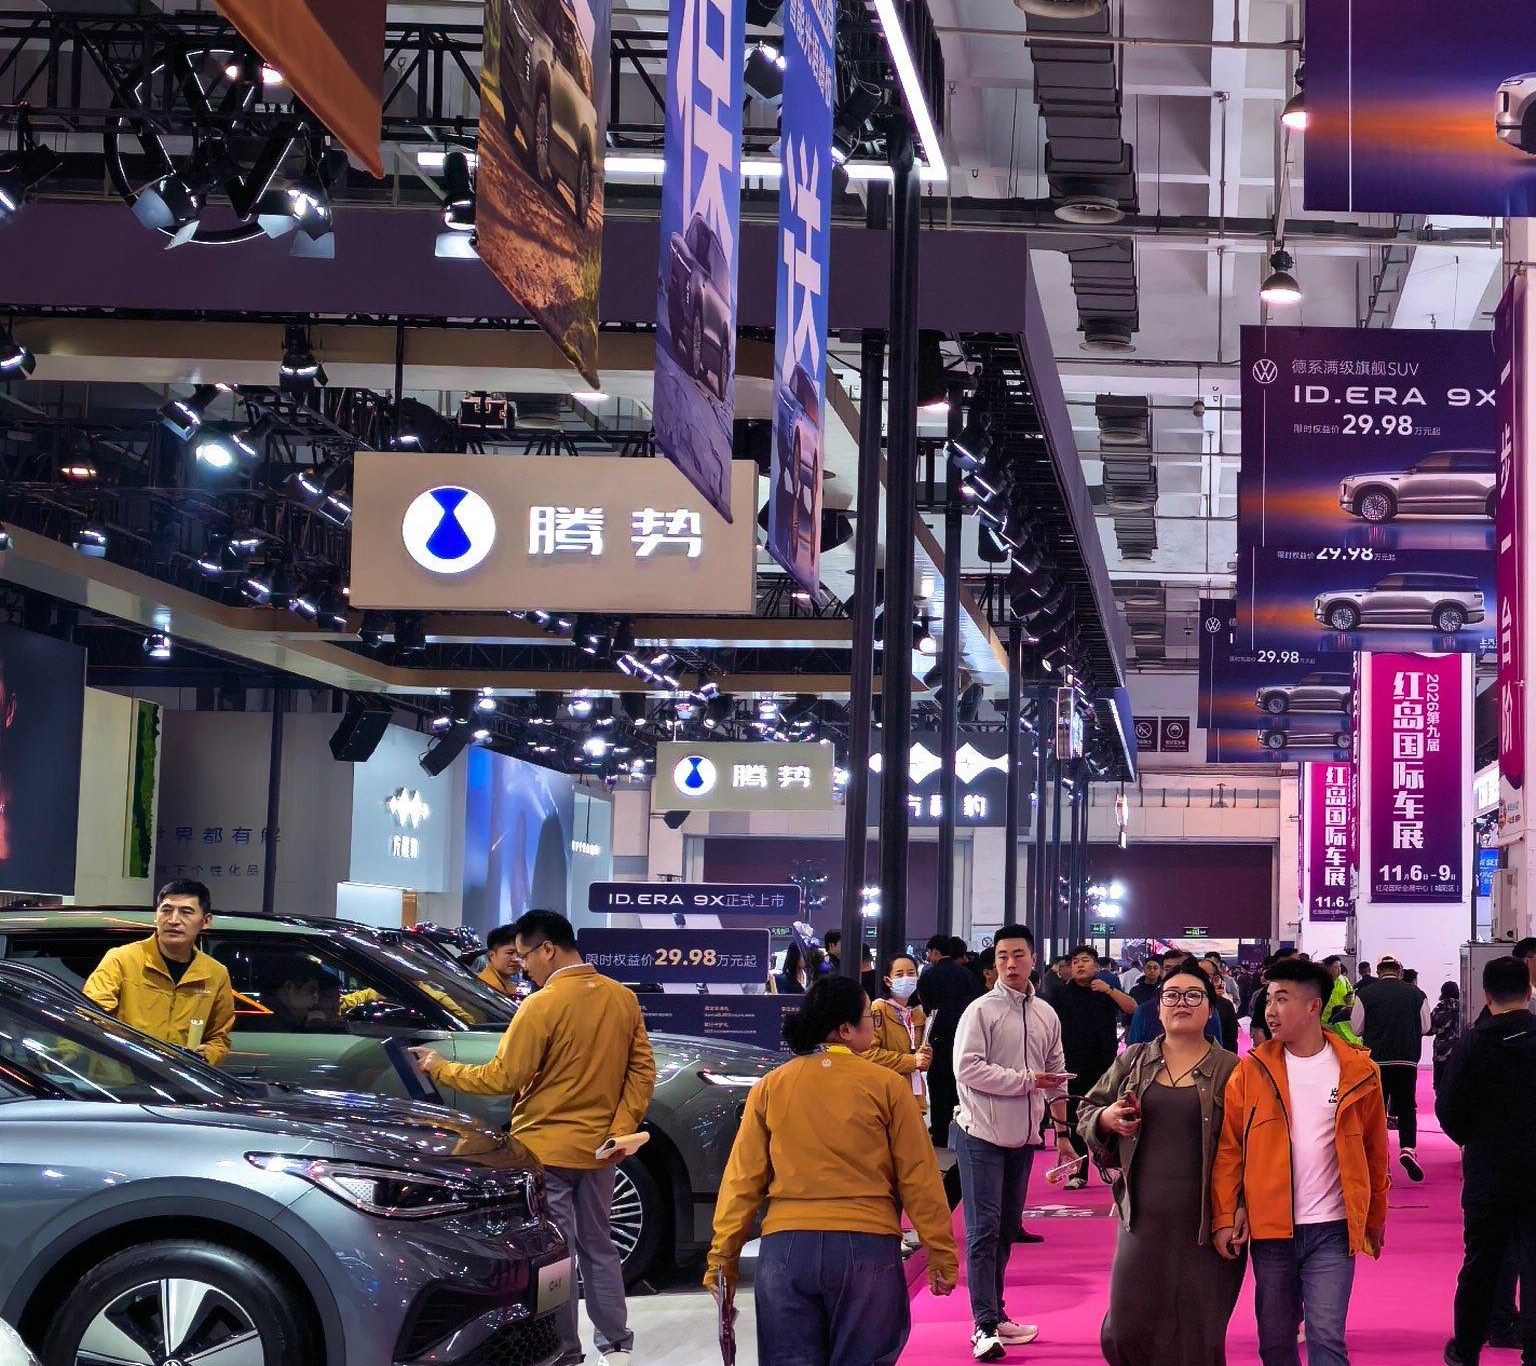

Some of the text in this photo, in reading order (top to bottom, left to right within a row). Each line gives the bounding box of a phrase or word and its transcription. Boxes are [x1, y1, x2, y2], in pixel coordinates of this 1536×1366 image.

[1291, 359, 1419, 377] 德系满级旗舰SUV
[1294, 385, 1496, 407] ID.ERA 9X
[529, 506, 703, 559] 腾势
[1426, 674, 1440, 752] 2026第九届
[1393, 672, 1424, 849] 红岛国际车展
[732, 763, 811, 787] 腾势
[608, 893, 684, 906] ID.ERA
